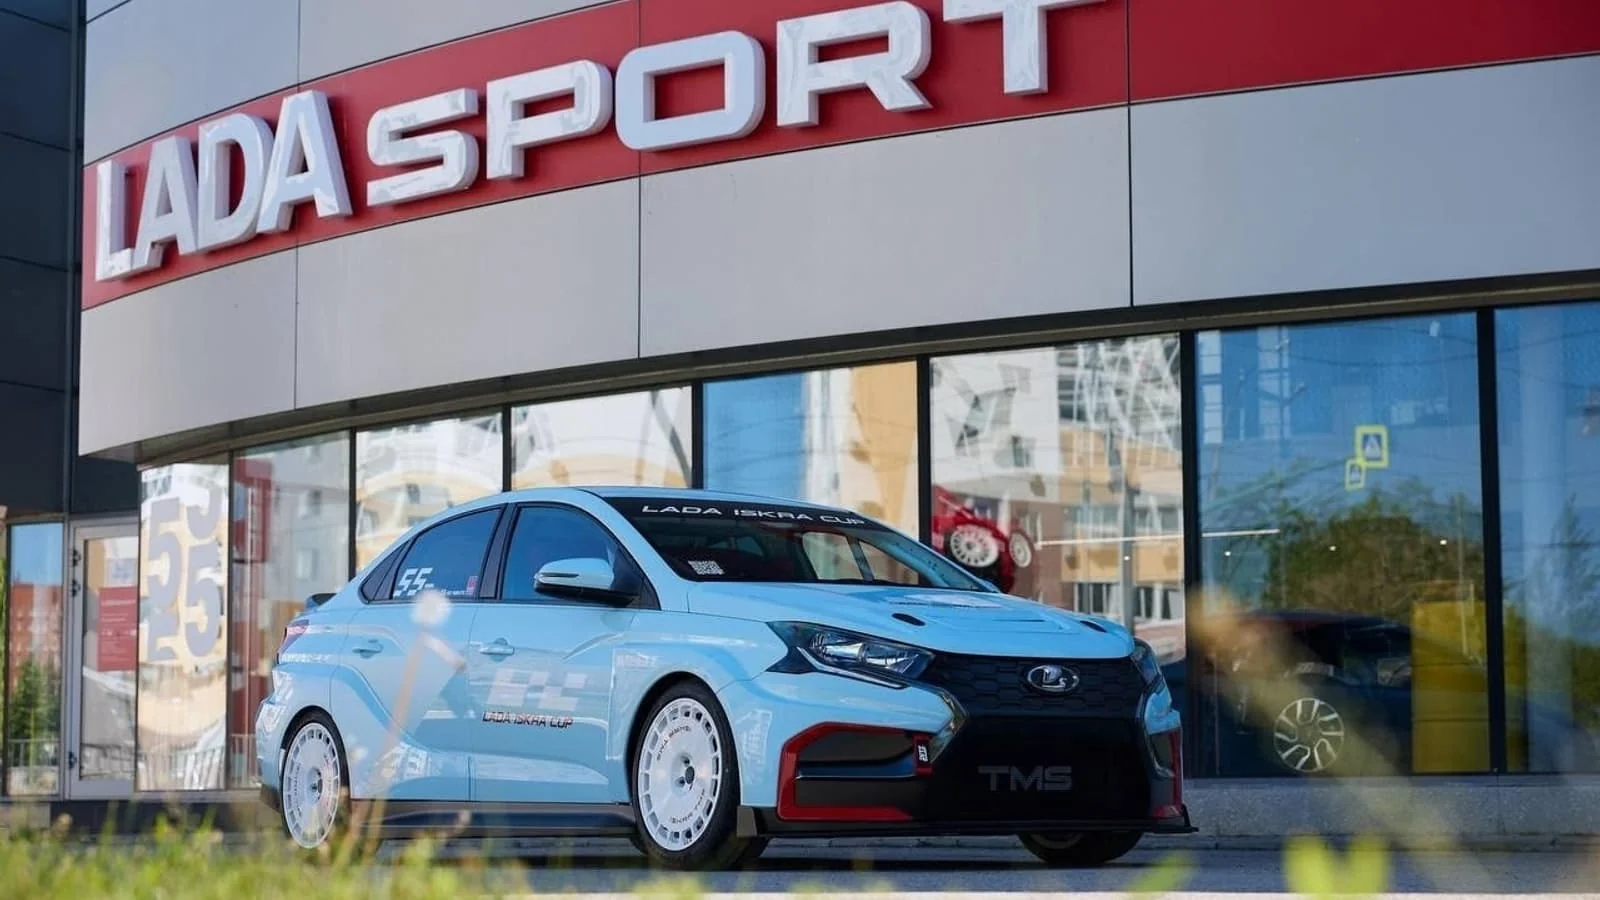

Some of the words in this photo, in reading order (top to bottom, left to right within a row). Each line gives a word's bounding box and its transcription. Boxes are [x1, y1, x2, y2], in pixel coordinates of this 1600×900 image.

[95, 89, 353, 282] LADA
[366, 0, 1106, 206] SPORT
[642, 505, 722, 515] LADA
[734, 508, 814, 521] ISKRA
[820, 515, 865, 525] CUP
[482, 711, 510, 723] LADA
[549, 715, 574, 729] CUP
[978, 765, 1072, 792] TMS
